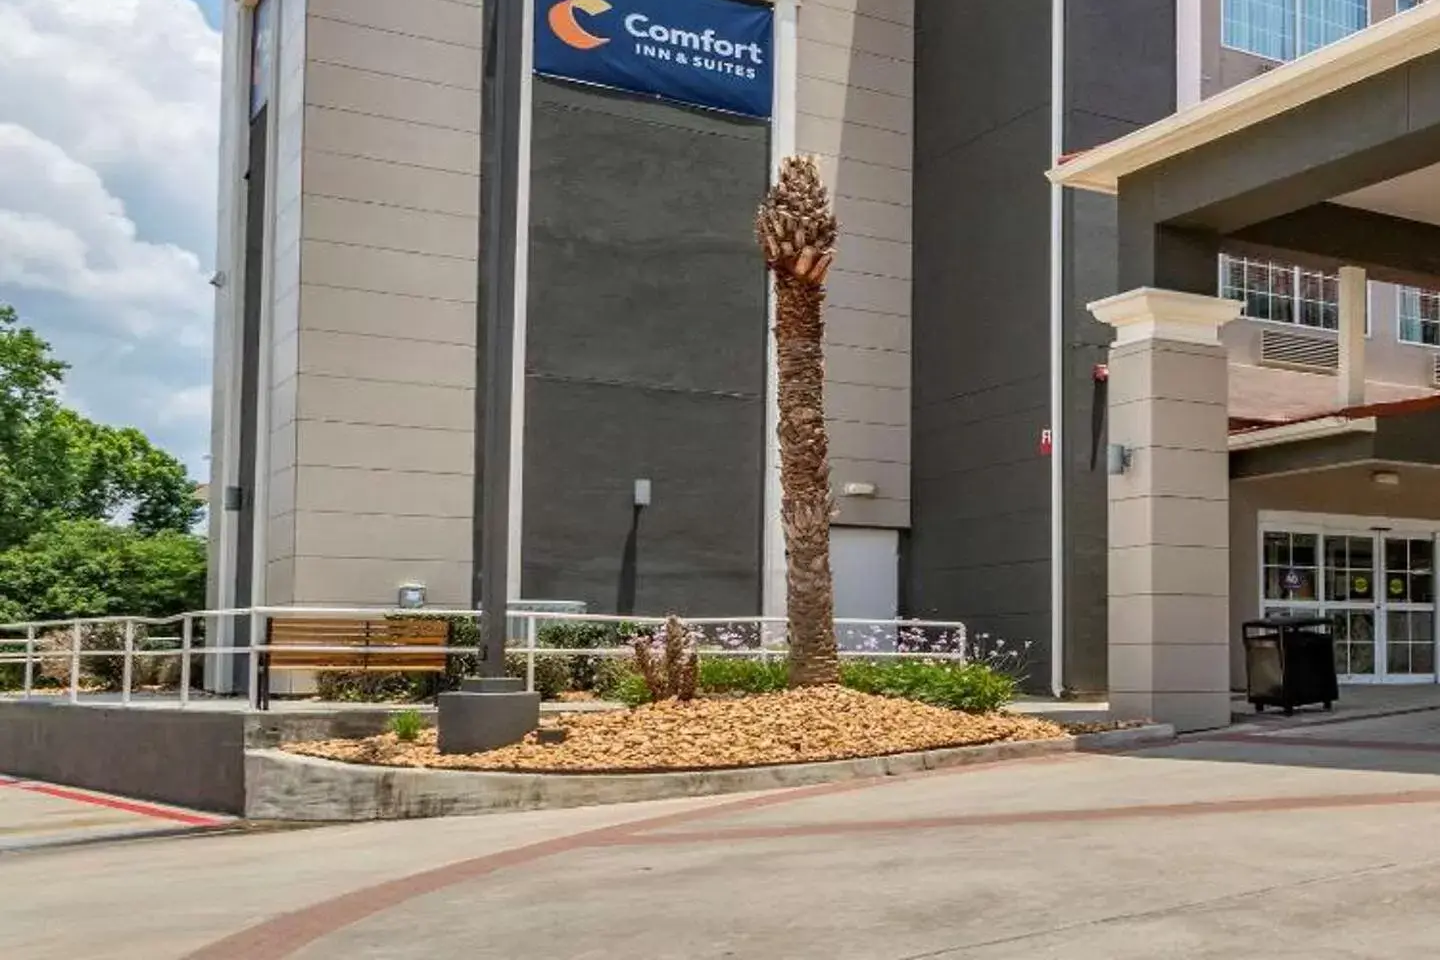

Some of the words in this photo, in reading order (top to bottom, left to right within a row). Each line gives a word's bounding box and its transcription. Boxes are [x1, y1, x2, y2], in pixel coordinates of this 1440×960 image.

[624, 13, 764, 65] Comfort
[635, 43, 672, 62] INN
[674, 52, 689, 66] &
[692, 56, 757, 81] SUITES
